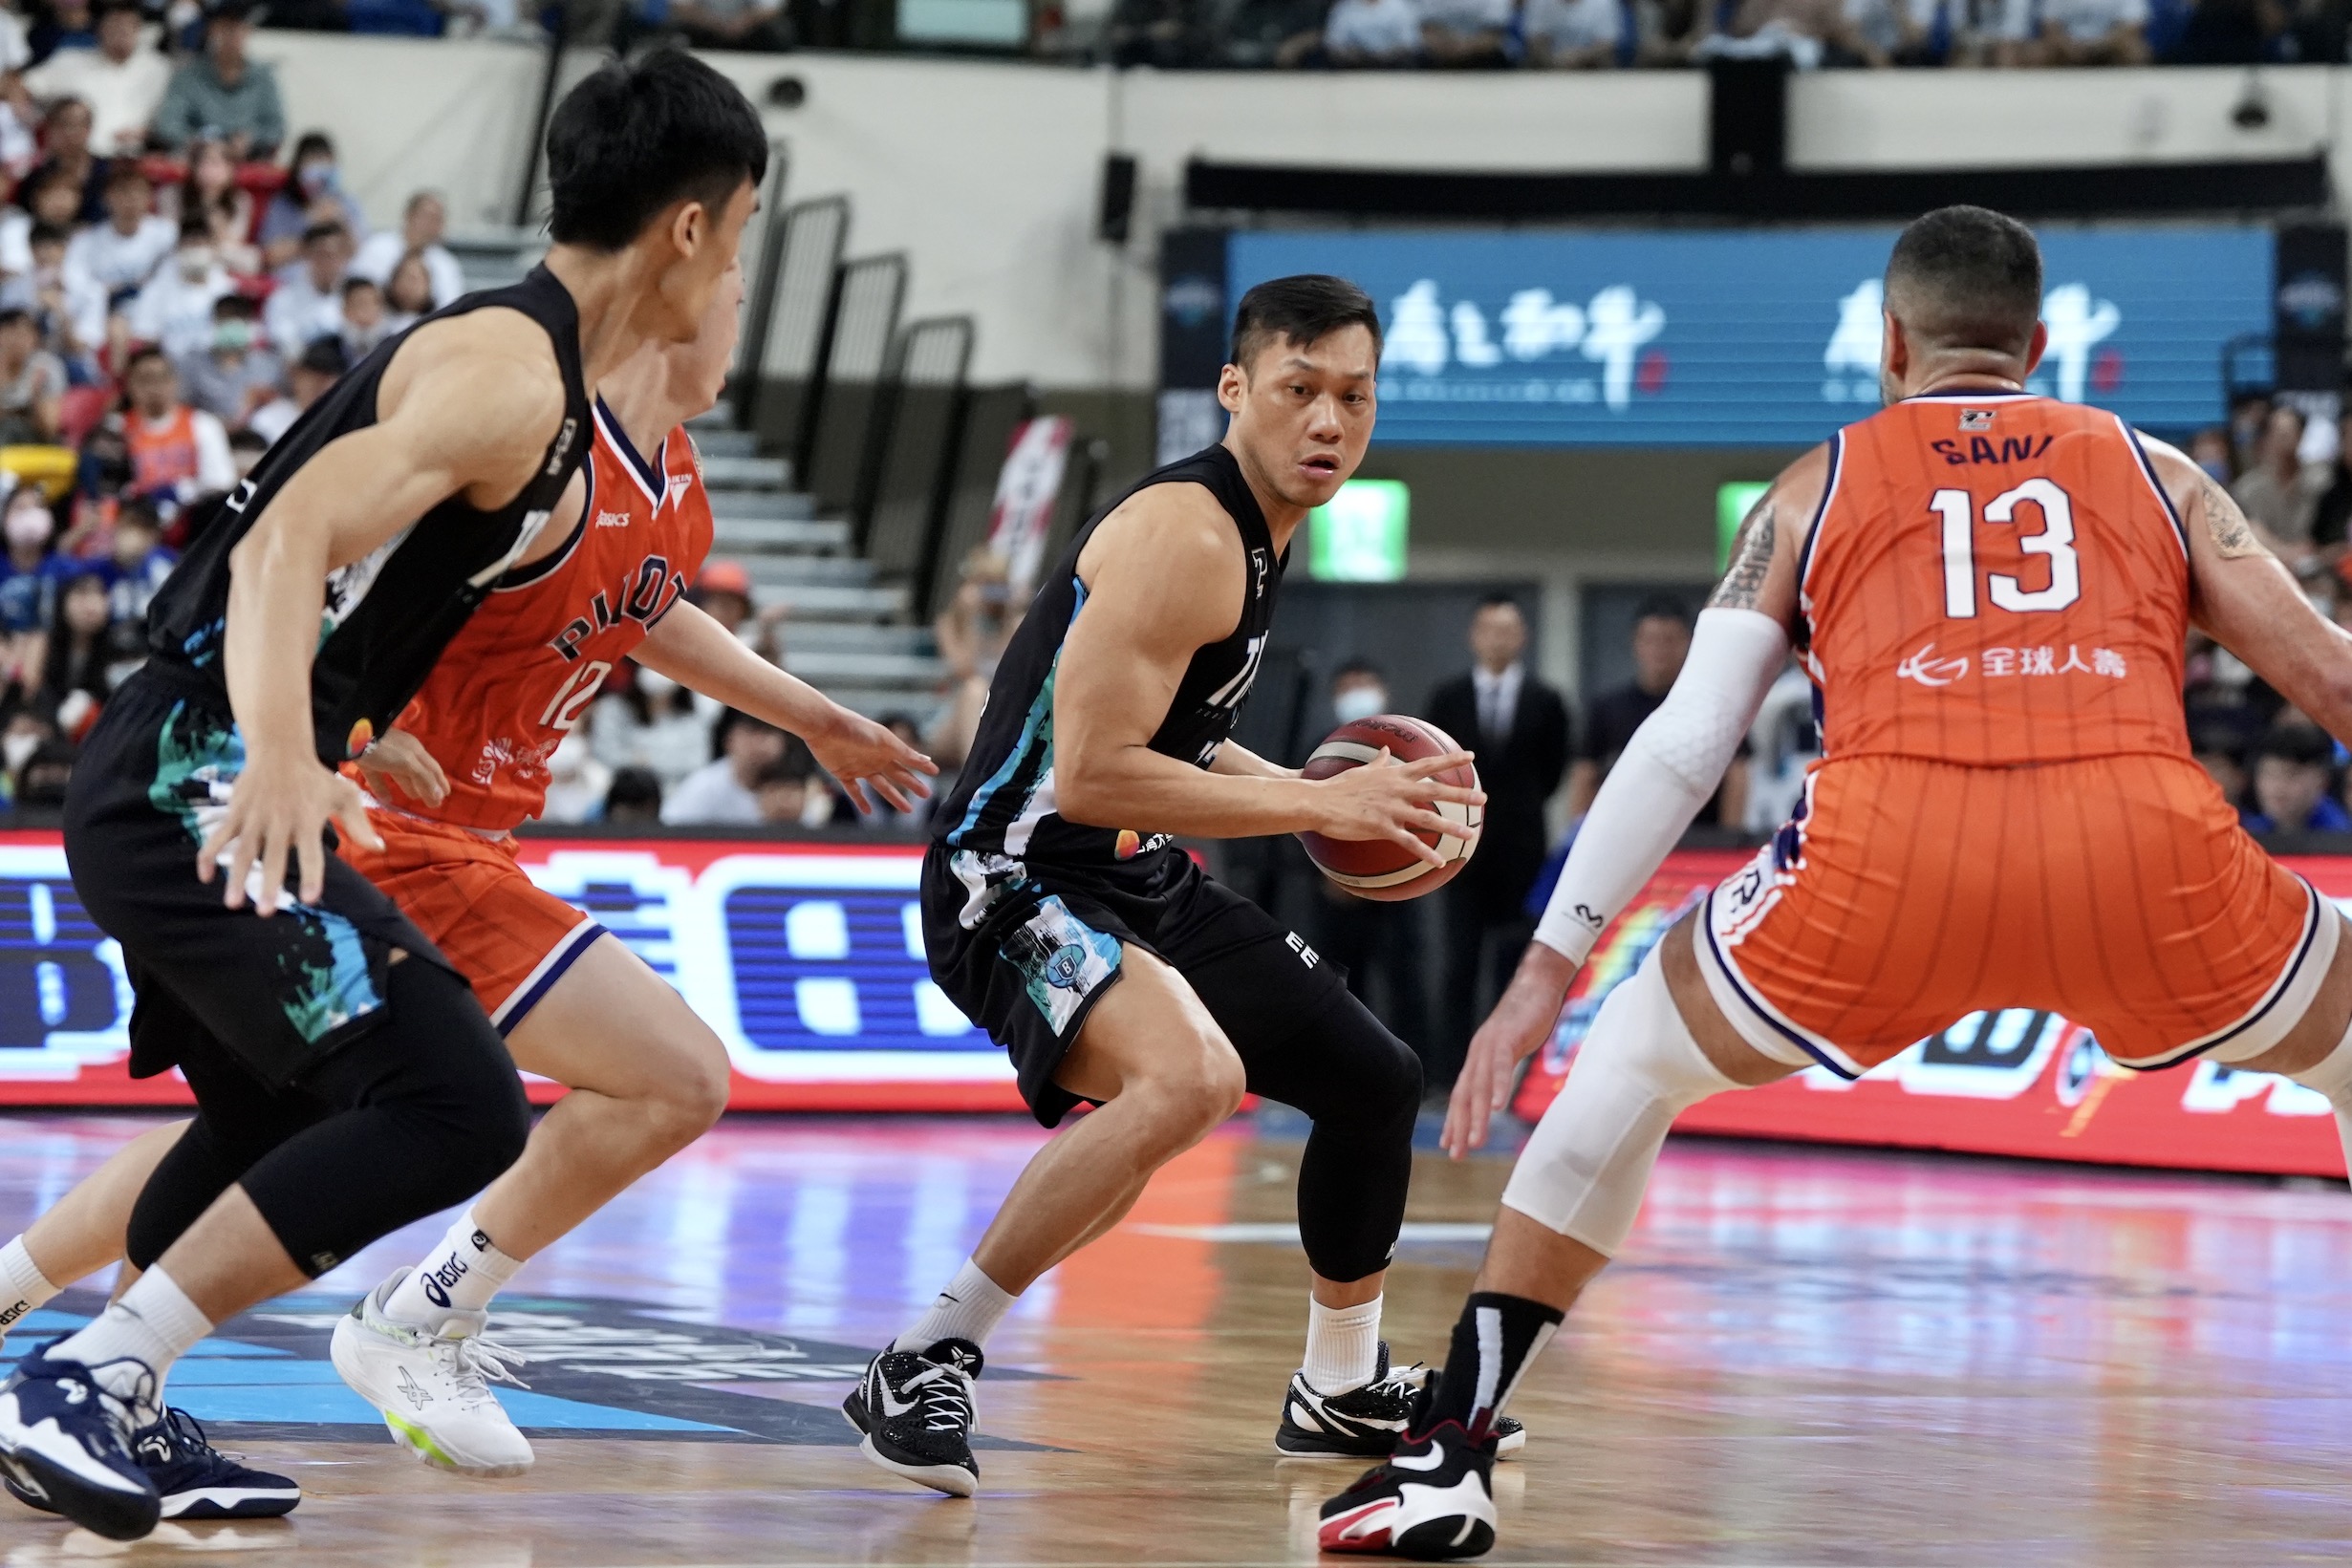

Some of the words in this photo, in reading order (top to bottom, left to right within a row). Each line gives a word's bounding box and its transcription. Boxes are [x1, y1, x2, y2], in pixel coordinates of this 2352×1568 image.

[1931, 435, 2054, 466] SANI
[1929, 477, 2082, 619] 13
[1981, 643, 2127, 679] 全球人壽
[537, 659, 613, 730] 12
[1062, 960, 1072, 975] B
